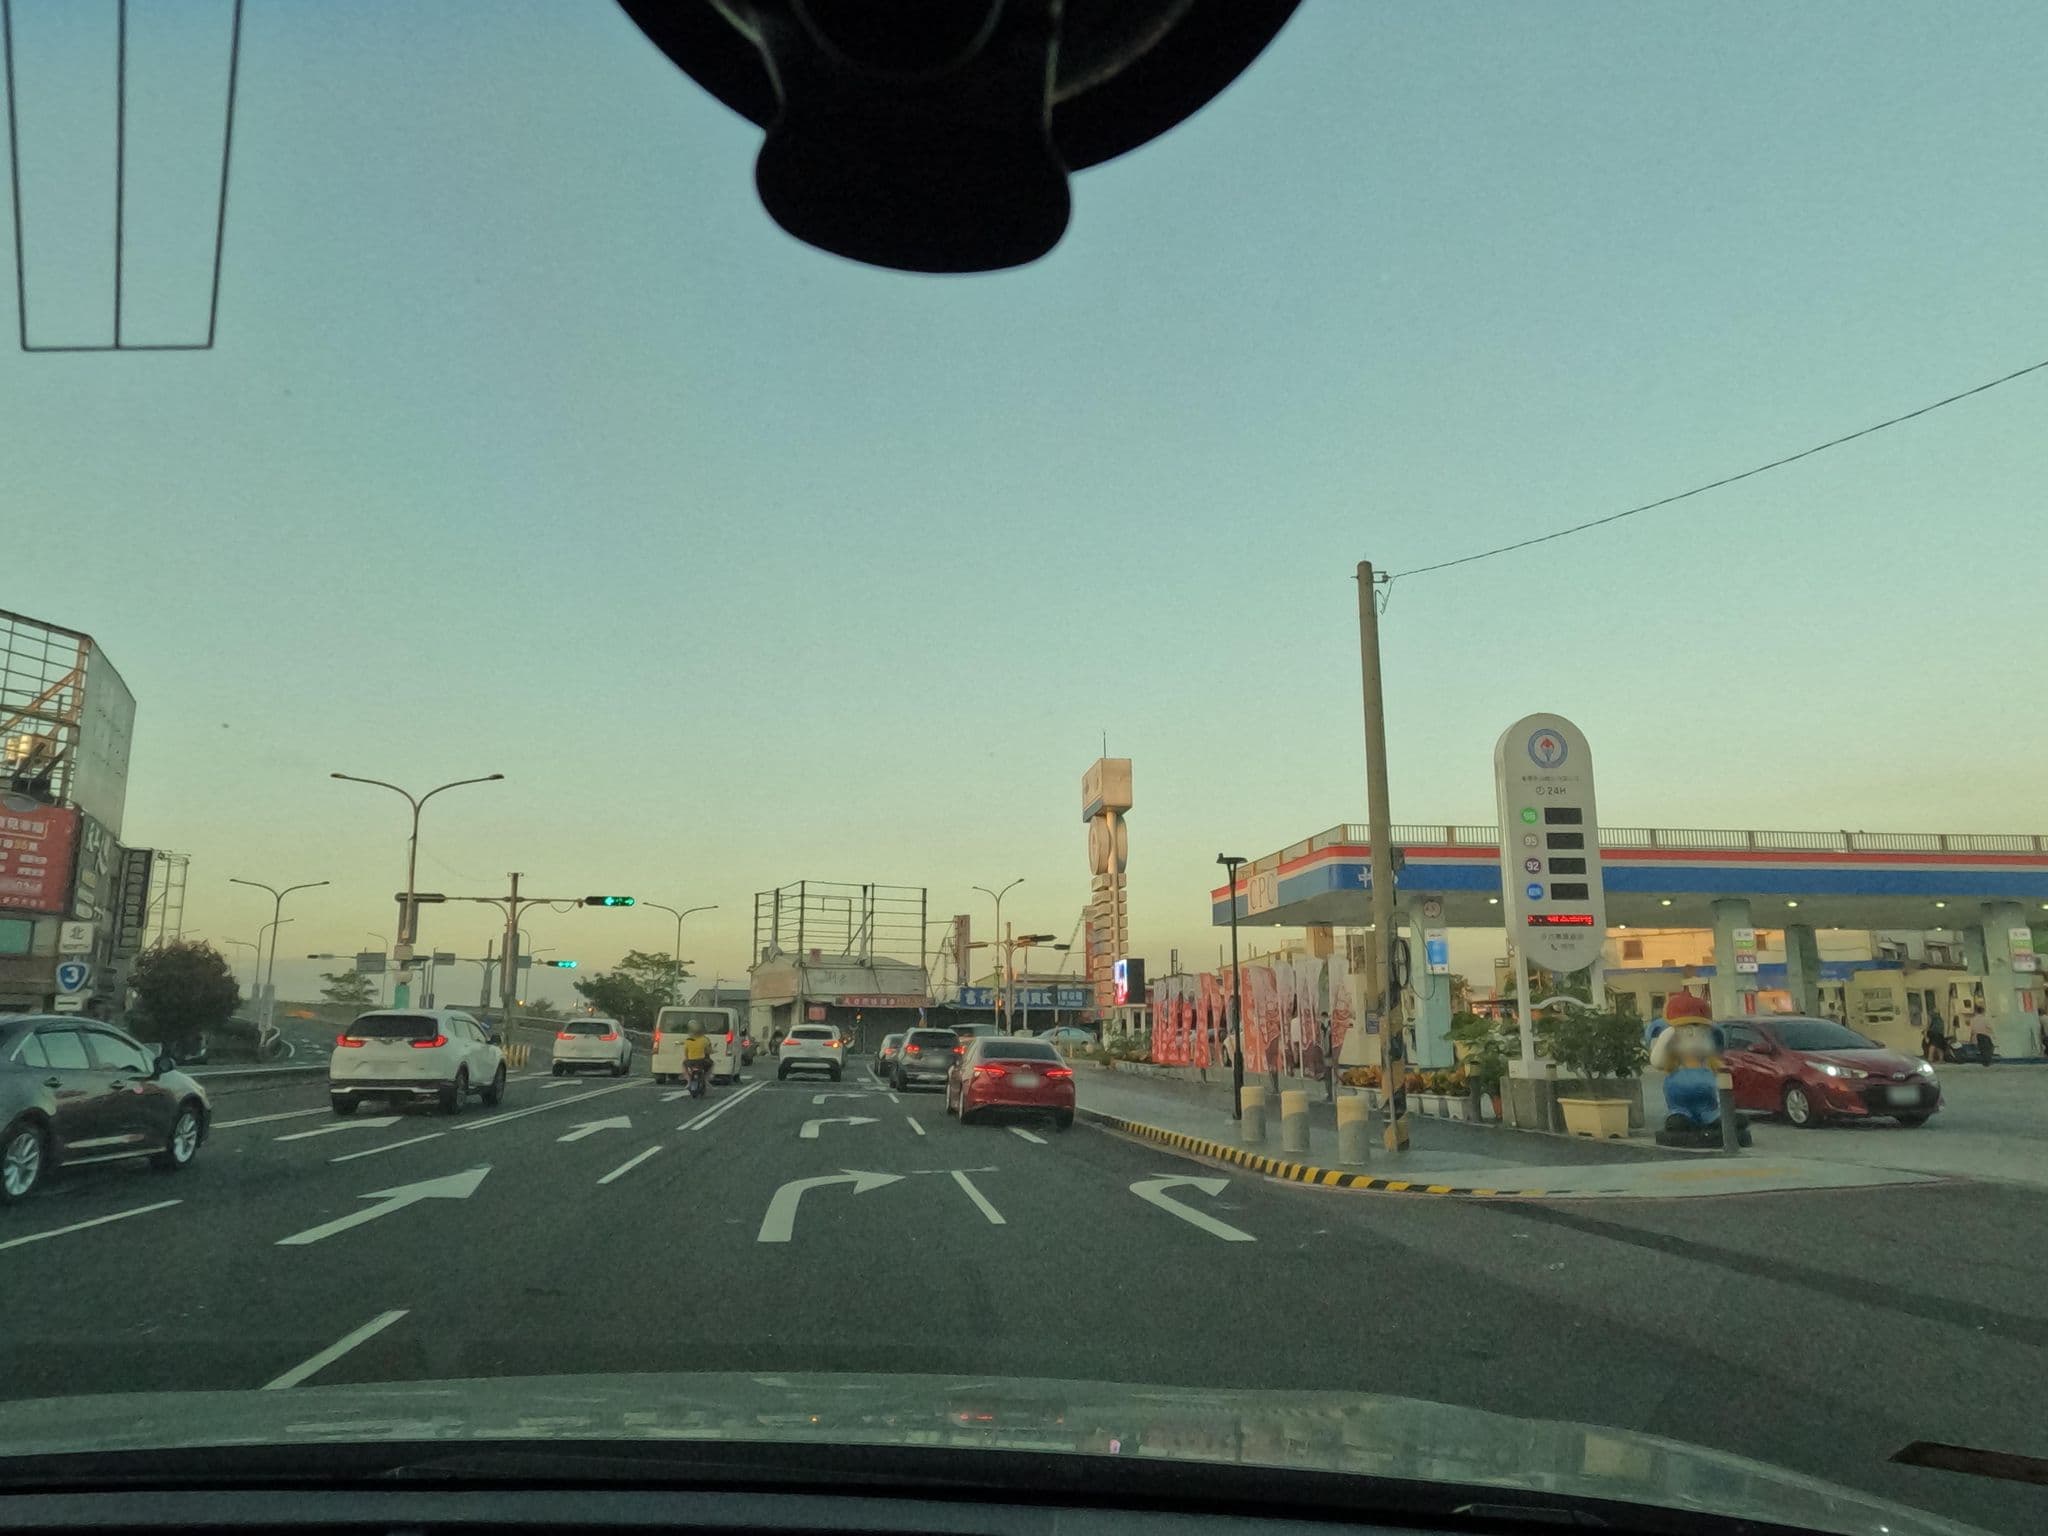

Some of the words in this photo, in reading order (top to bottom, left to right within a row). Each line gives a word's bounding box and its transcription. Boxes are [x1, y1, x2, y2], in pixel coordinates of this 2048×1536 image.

[1547, 787, 1567, 795] 24H
[1525, 834, 1538, 846] 95
[1527, 861, 1540, 871] 92
[1250, 871, 1277, 910] CPC
[64, 966, 79, 983] 3
